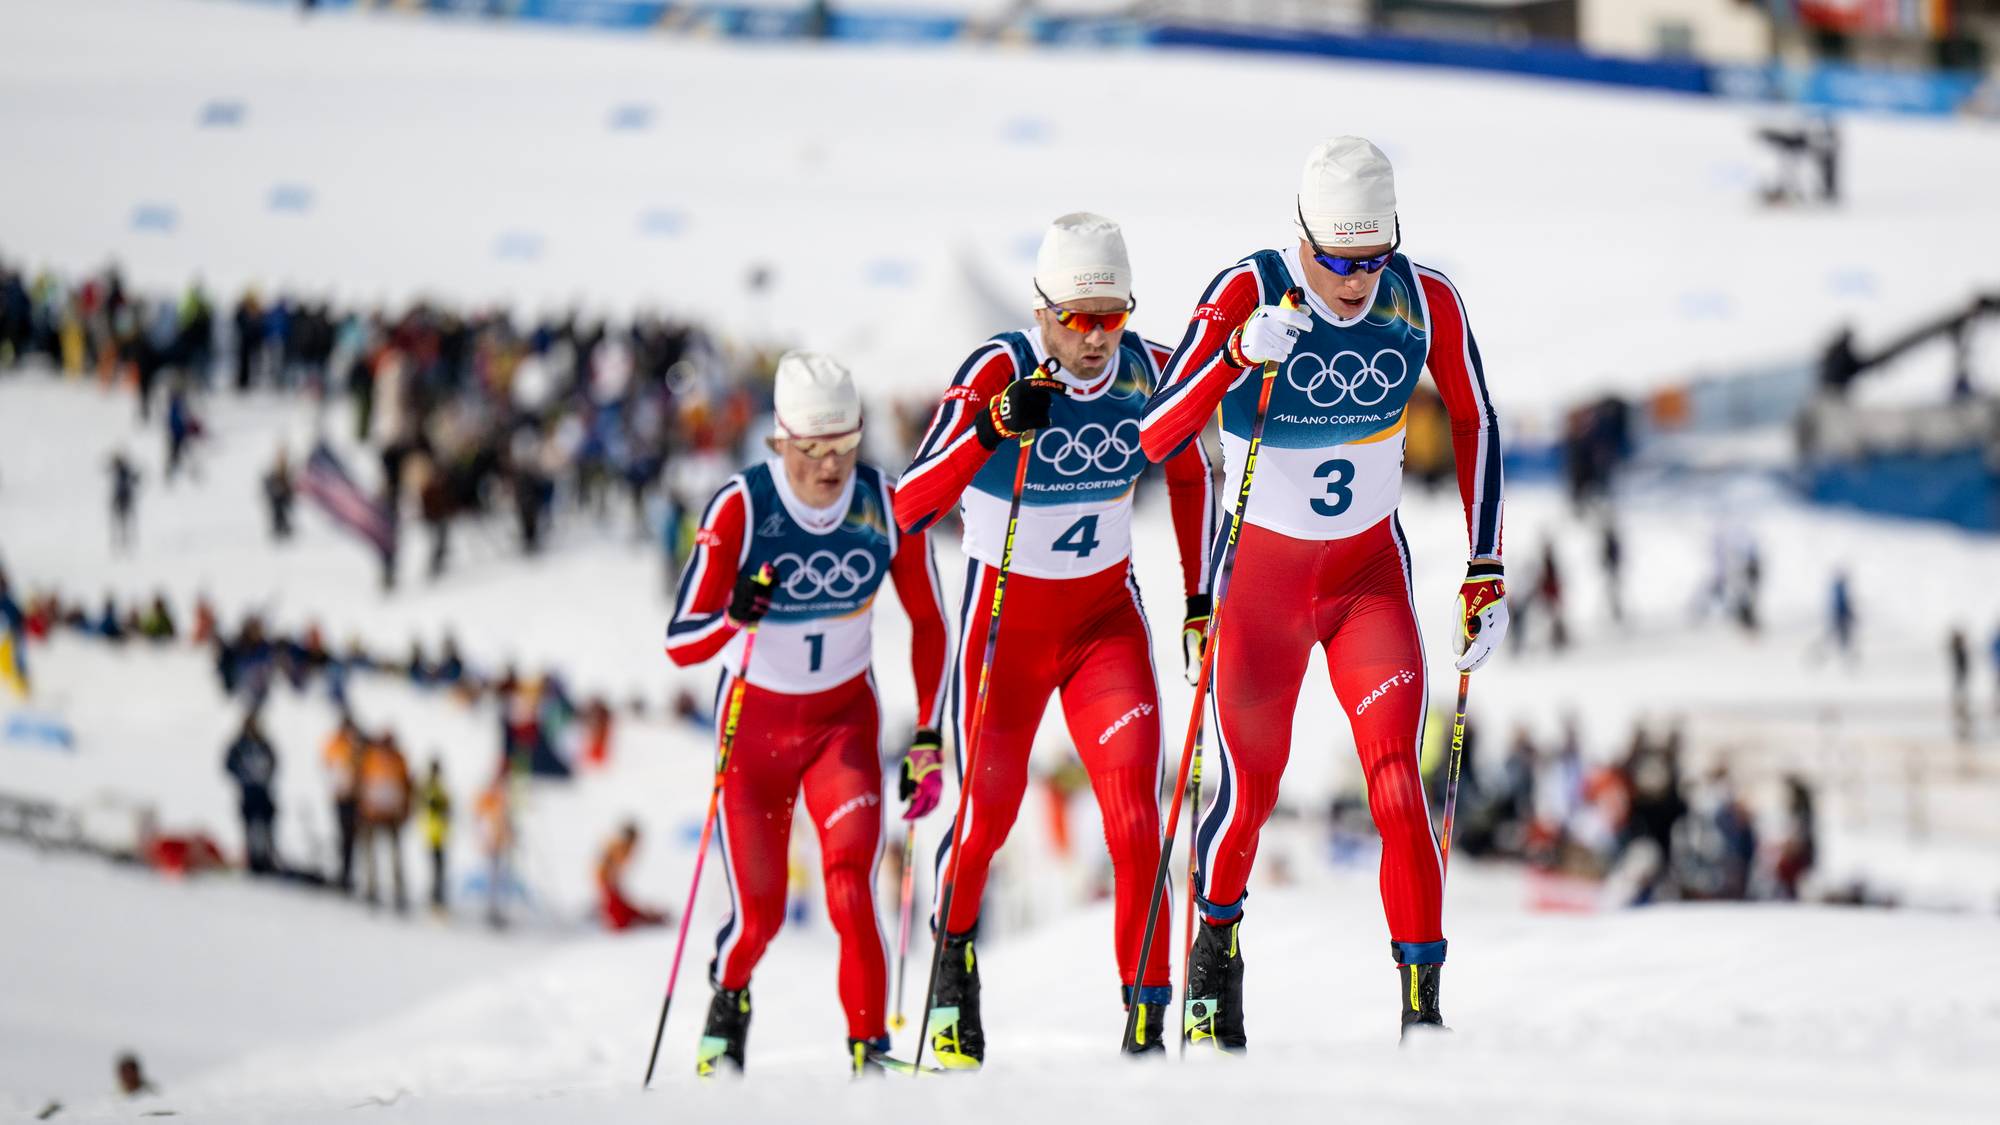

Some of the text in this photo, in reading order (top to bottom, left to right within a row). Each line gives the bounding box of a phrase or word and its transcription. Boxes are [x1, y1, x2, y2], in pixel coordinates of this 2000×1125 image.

[1333, 219, 1379, 231] NORGE
[1073, 272, 1116, 282] NORGE
[1273, 413, 1328, 425] MILANO
[1329, 414, 1382, 425] CORTINA
[1023, 479, 1127, 492] MILANO CORTINA
[1242, 437, 1262, 496] LEKI
[1309, 458, 1356, 517] 3
[1003, 518, 1018, 572] LEKI
[1051, 513, 1101, 559] 4
[804, 632, 825, 673] 1
[1356, 675, 1400, 716] CRAFT
[1098, 707, 1141, 745] CRAFT
